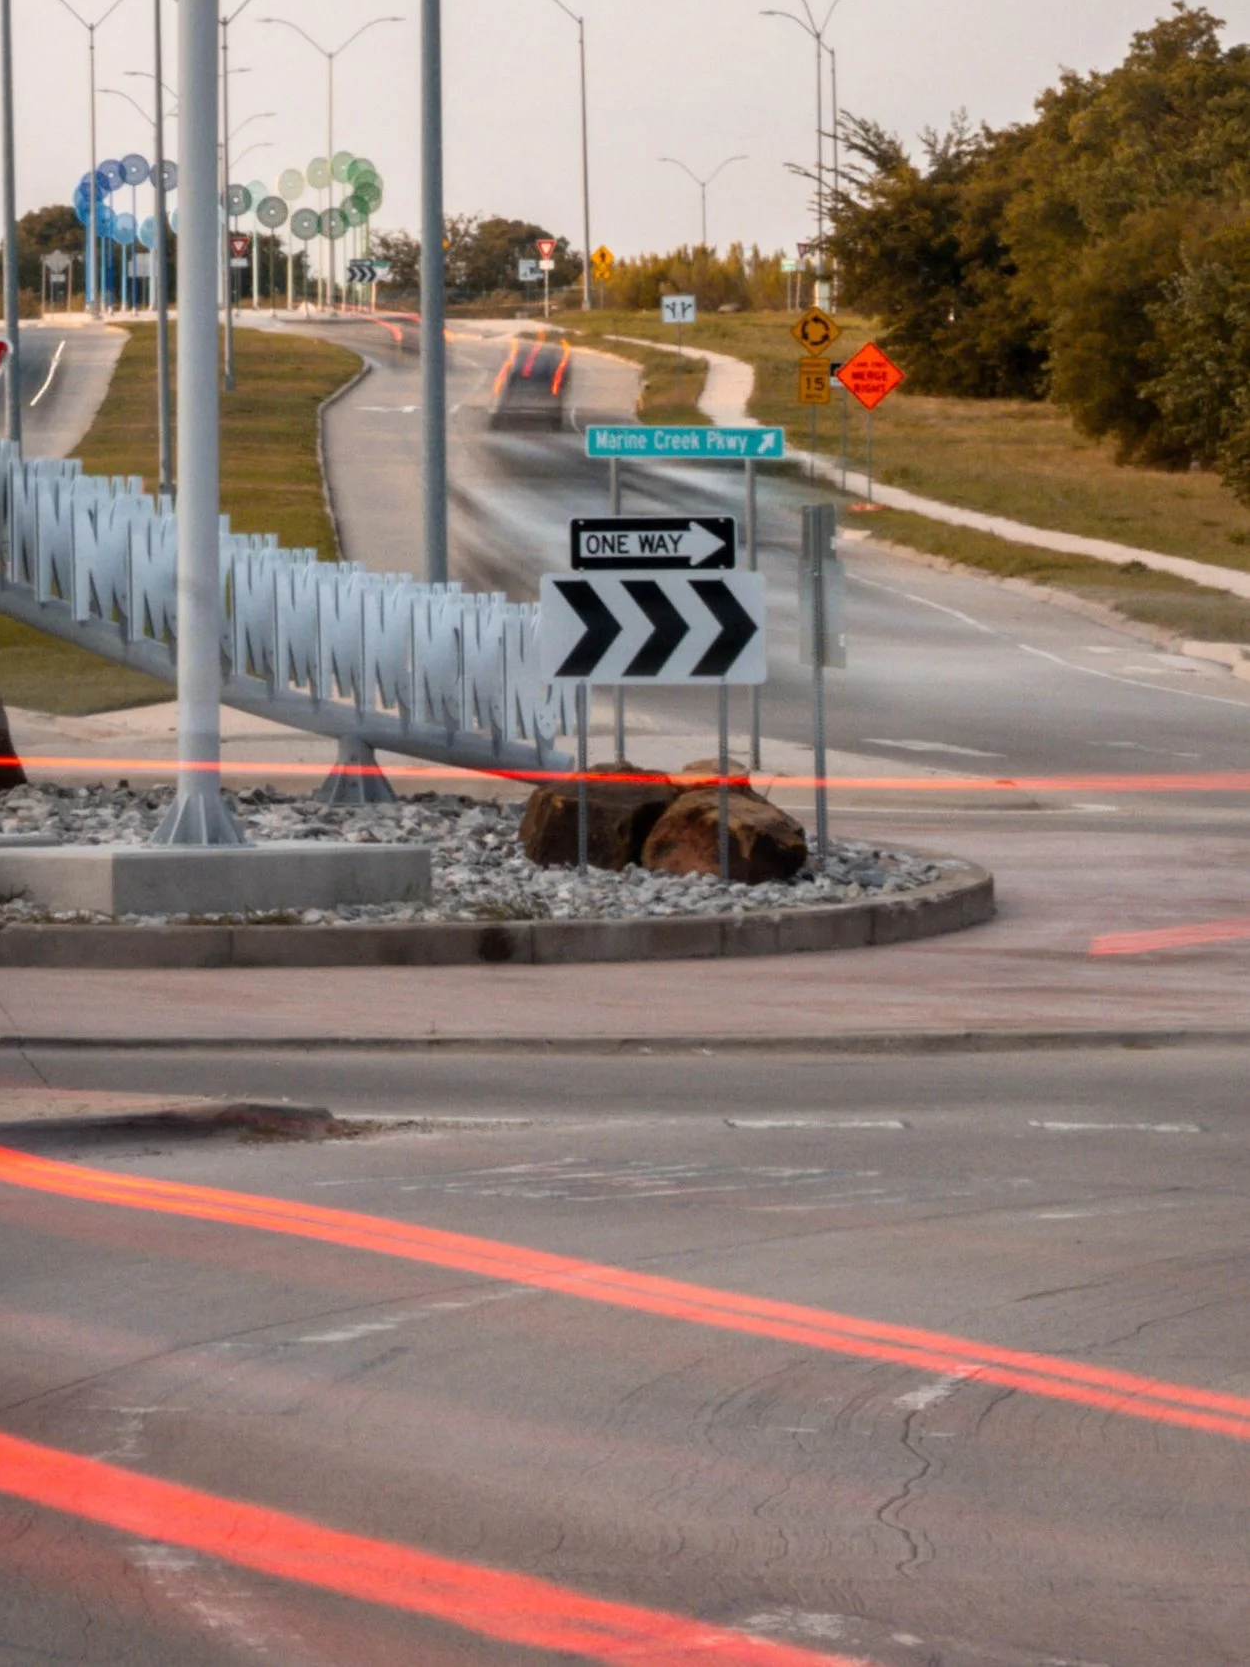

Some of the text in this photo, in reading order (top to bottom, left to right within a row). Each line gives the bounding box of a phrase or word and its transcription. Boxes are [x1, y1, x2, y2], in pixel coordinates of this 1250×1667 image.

[805, 376, 826, 392] 15
[595, 430, 749, 454] Marine Creek Pkwy
[586, 534, 684, 555] ONE WAY
